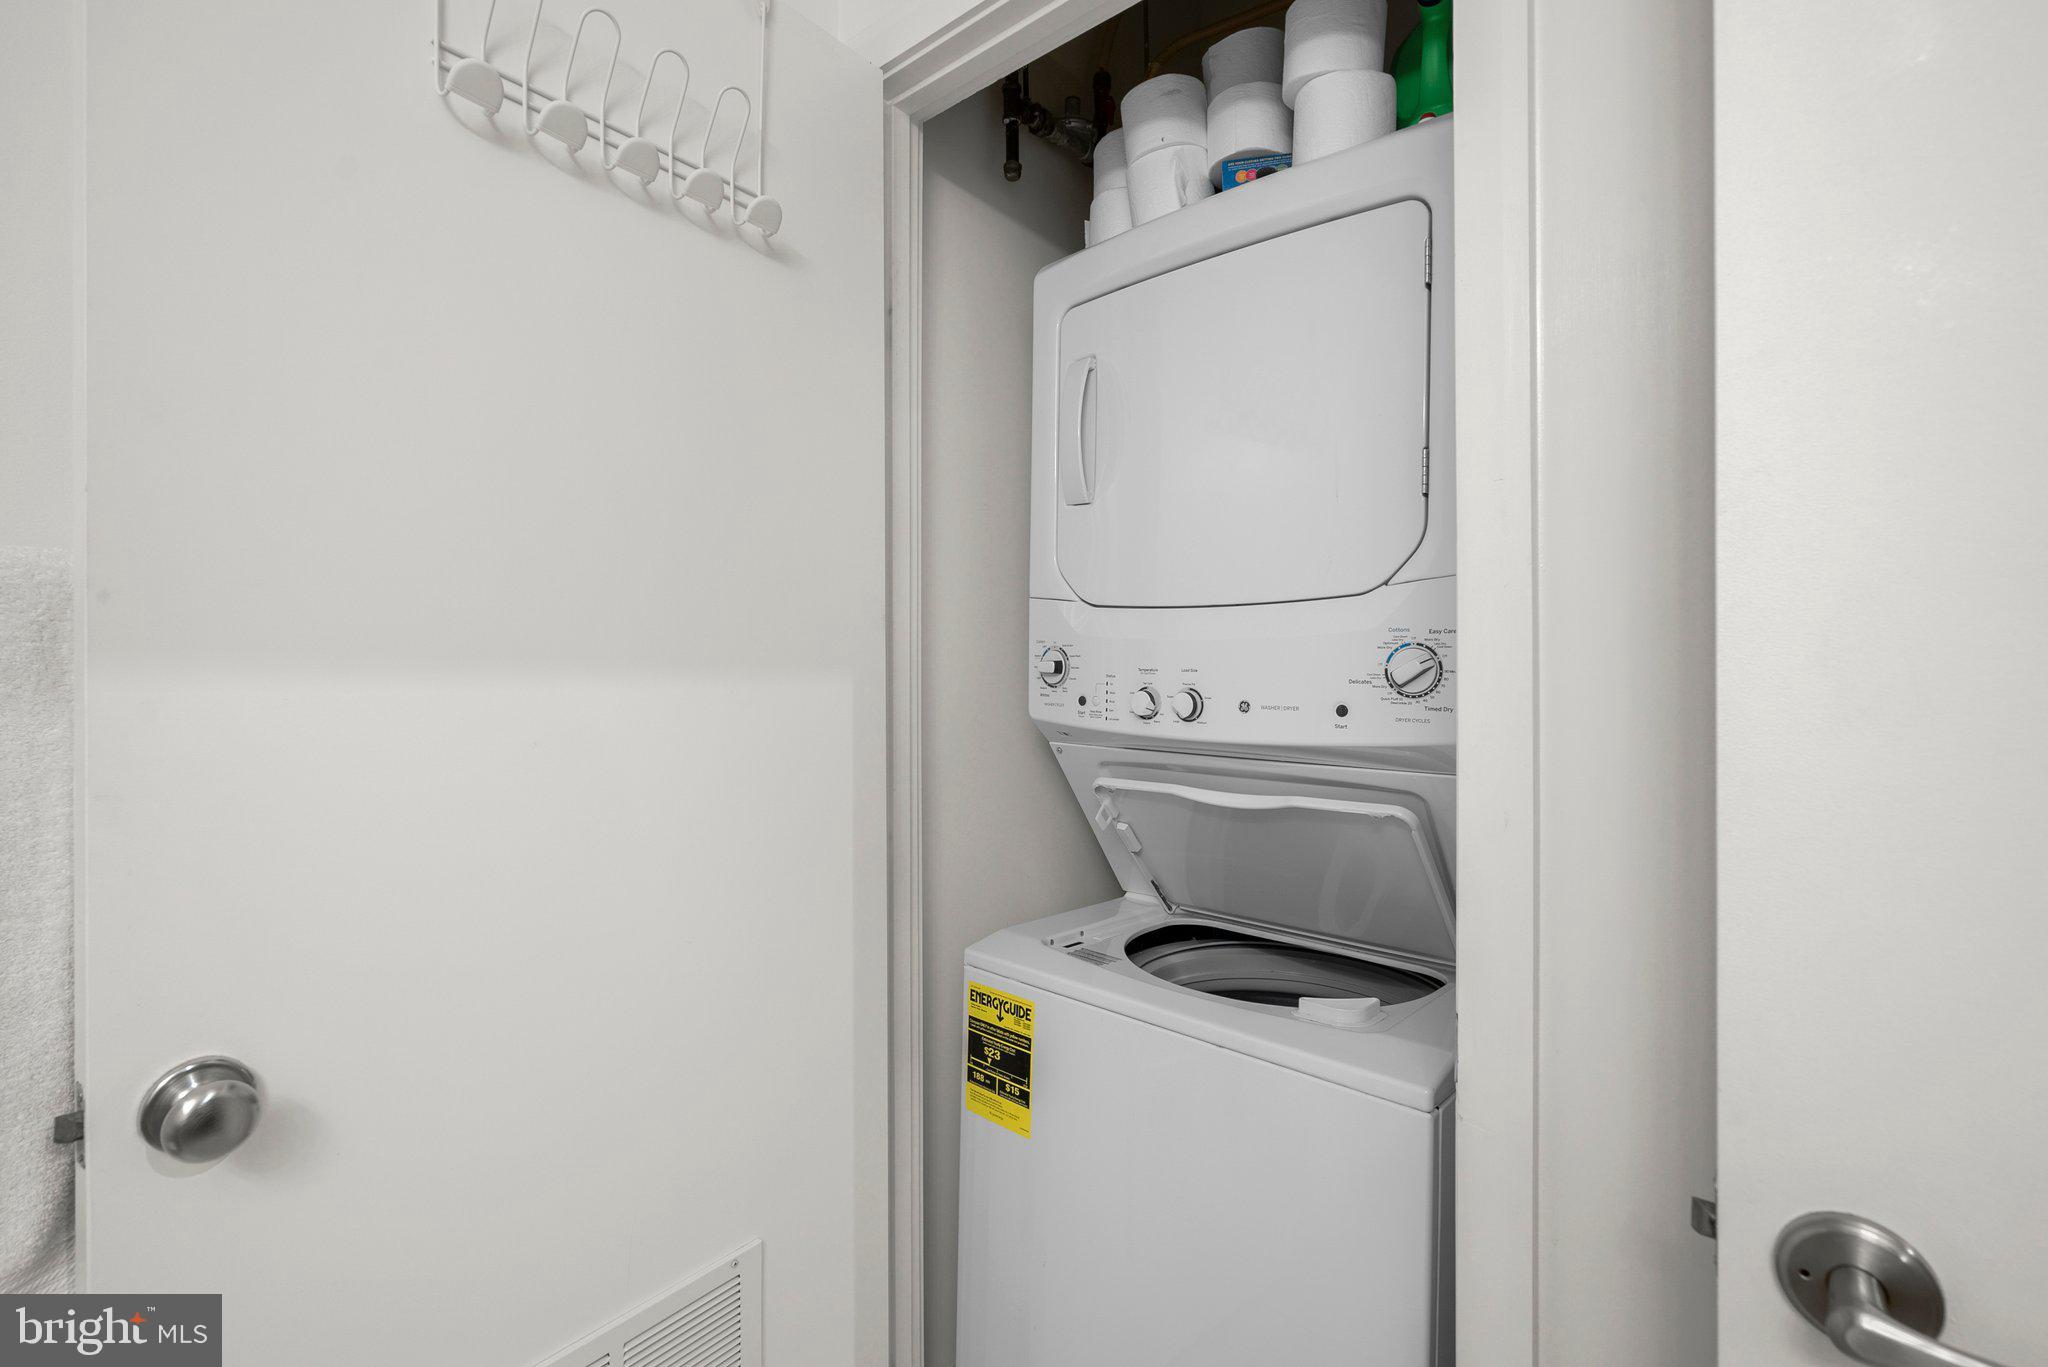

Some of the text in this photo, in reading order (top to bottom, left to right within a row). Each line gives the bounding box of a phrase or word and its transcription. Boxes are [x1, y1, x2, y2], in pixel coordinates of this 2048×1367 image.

[970, 988, 1032, 1022] ENERGYGUIDE
[983, 1046, 1001, 1061] $23
[1005, 1083, 1020, 1096] $15
